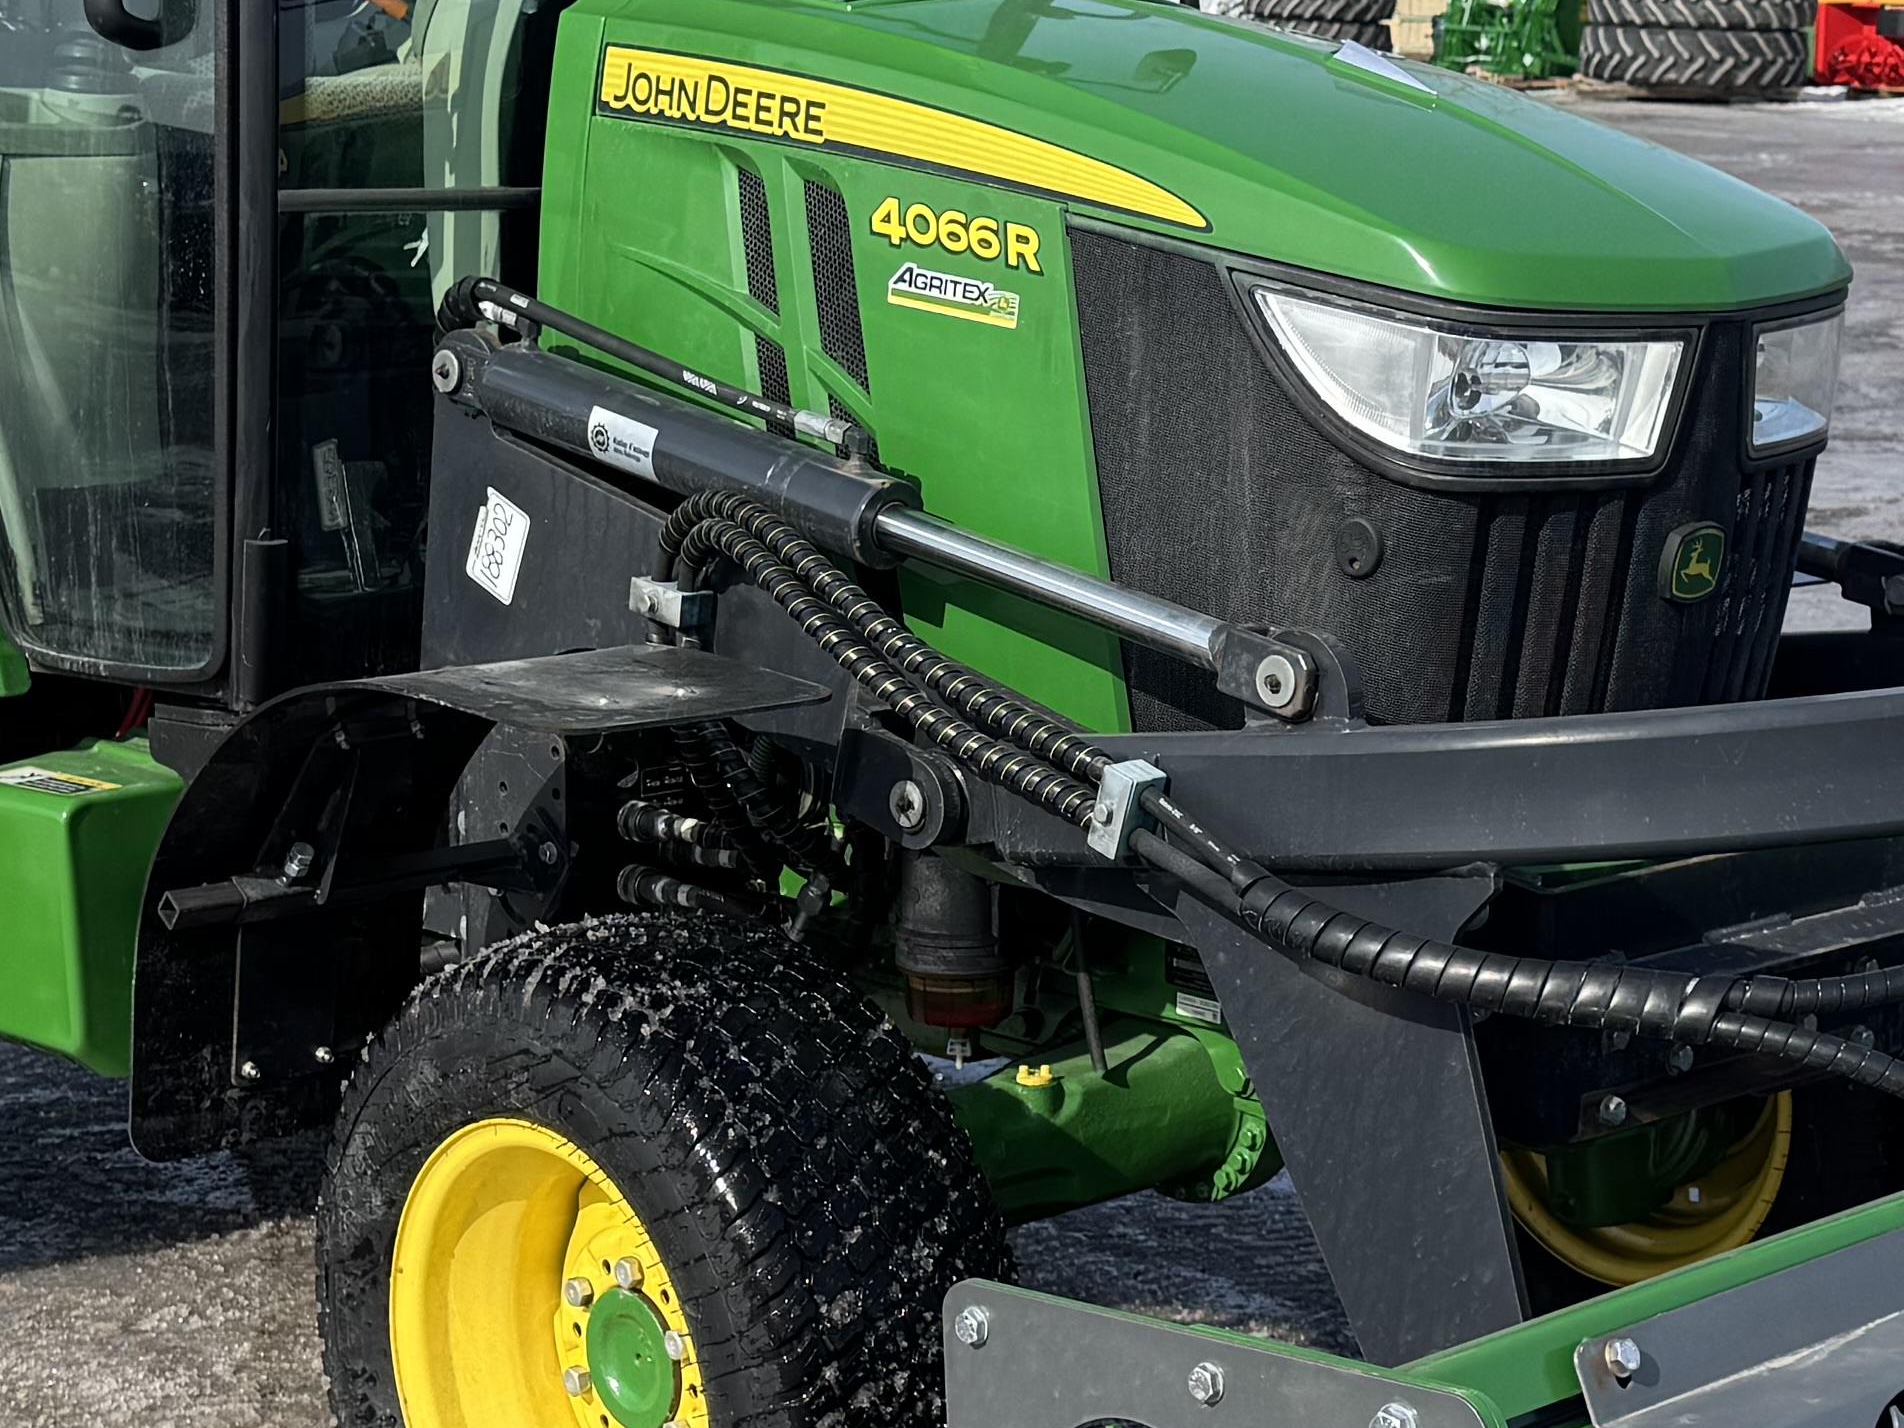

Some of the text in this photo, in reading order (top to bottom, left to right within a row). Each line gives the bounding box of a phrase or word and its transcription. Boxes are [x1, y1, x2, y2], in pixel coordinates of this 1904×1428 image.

[613, 62, 827, 137] JOHN DEERE
[892, 265, 990, 305] AGRITEX
[480, 502, 514, 589] 188302
